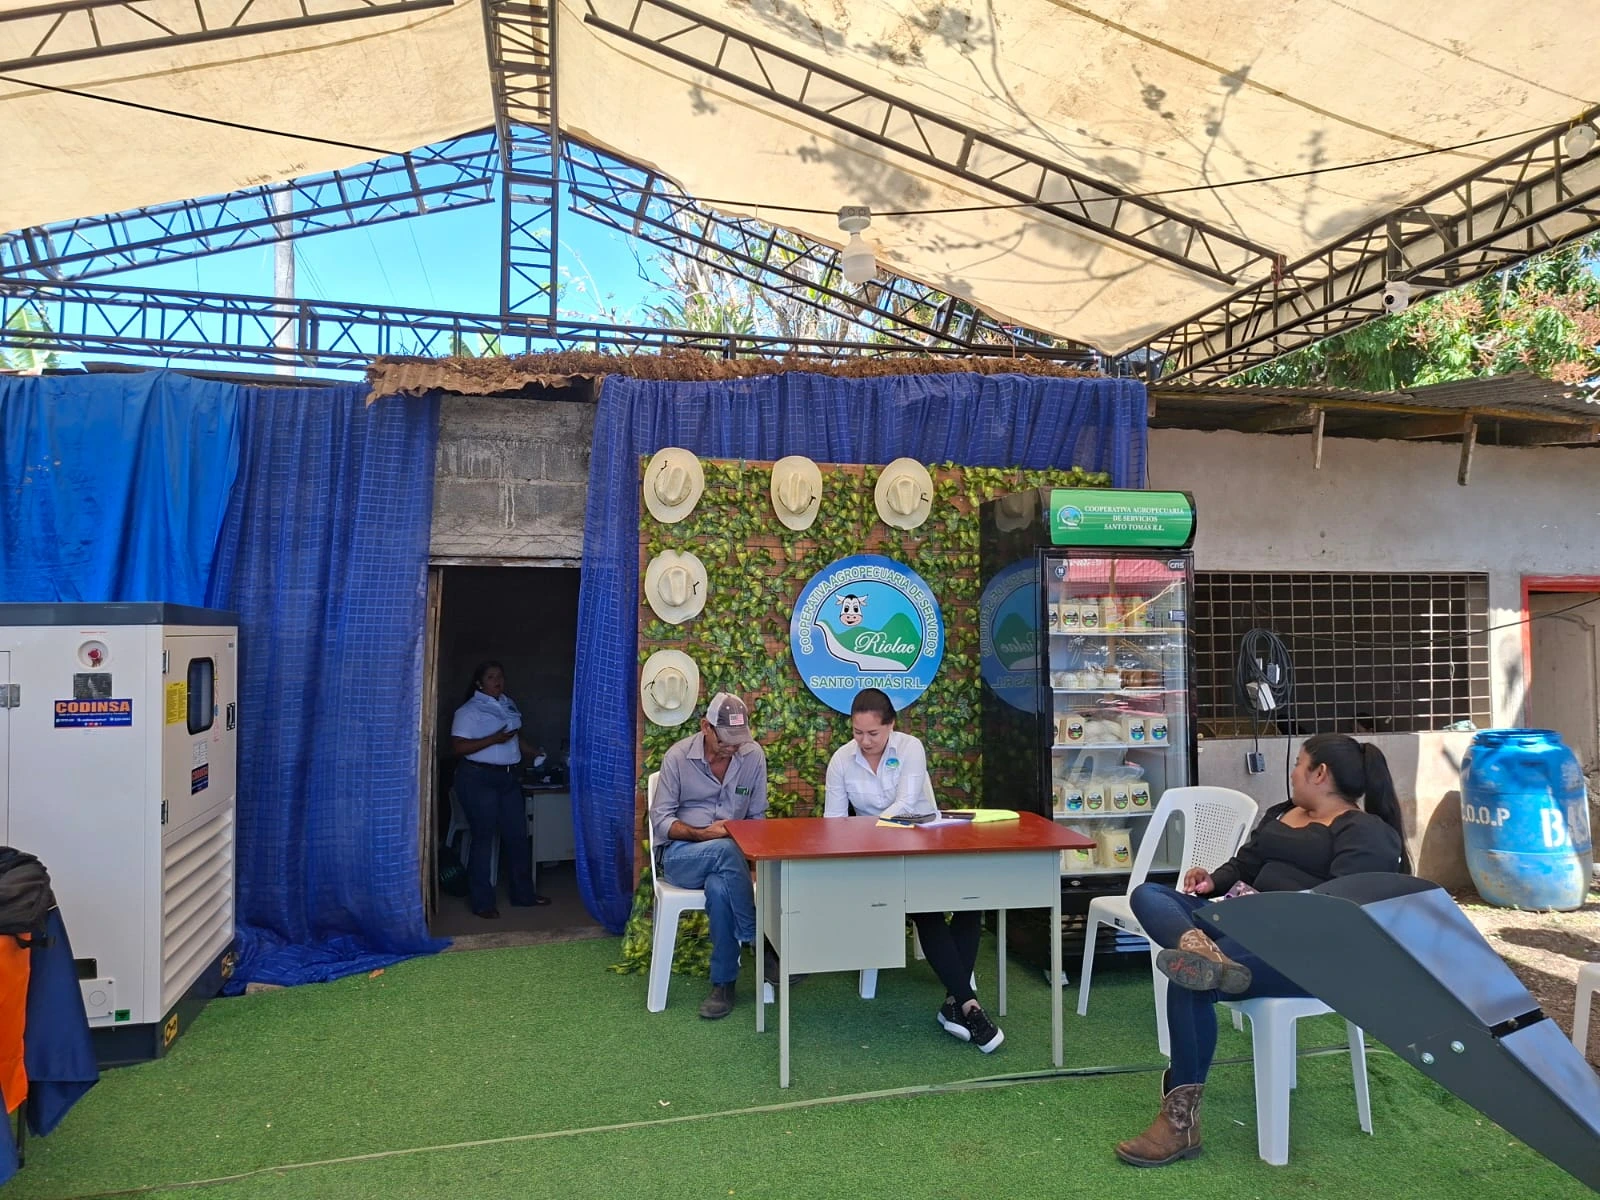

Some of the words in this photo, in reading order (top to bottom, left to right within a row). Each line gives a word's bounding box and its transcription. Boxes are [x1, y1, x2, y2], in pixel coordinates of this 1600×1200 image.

[799, 580, 831, 655] COOPERATIVA
[830, 566, 910, 592] AGROPECUARIA
[909, 585, 925, 603] DE
[919, 599, 939, 658] SERVICIOS
[854, 631, 915, 655] Riolac
[810, 675, 854, 689] SANTO
[903, 676, 927, 689] R.L.
[56, 702, 130, 713] CODINSA
